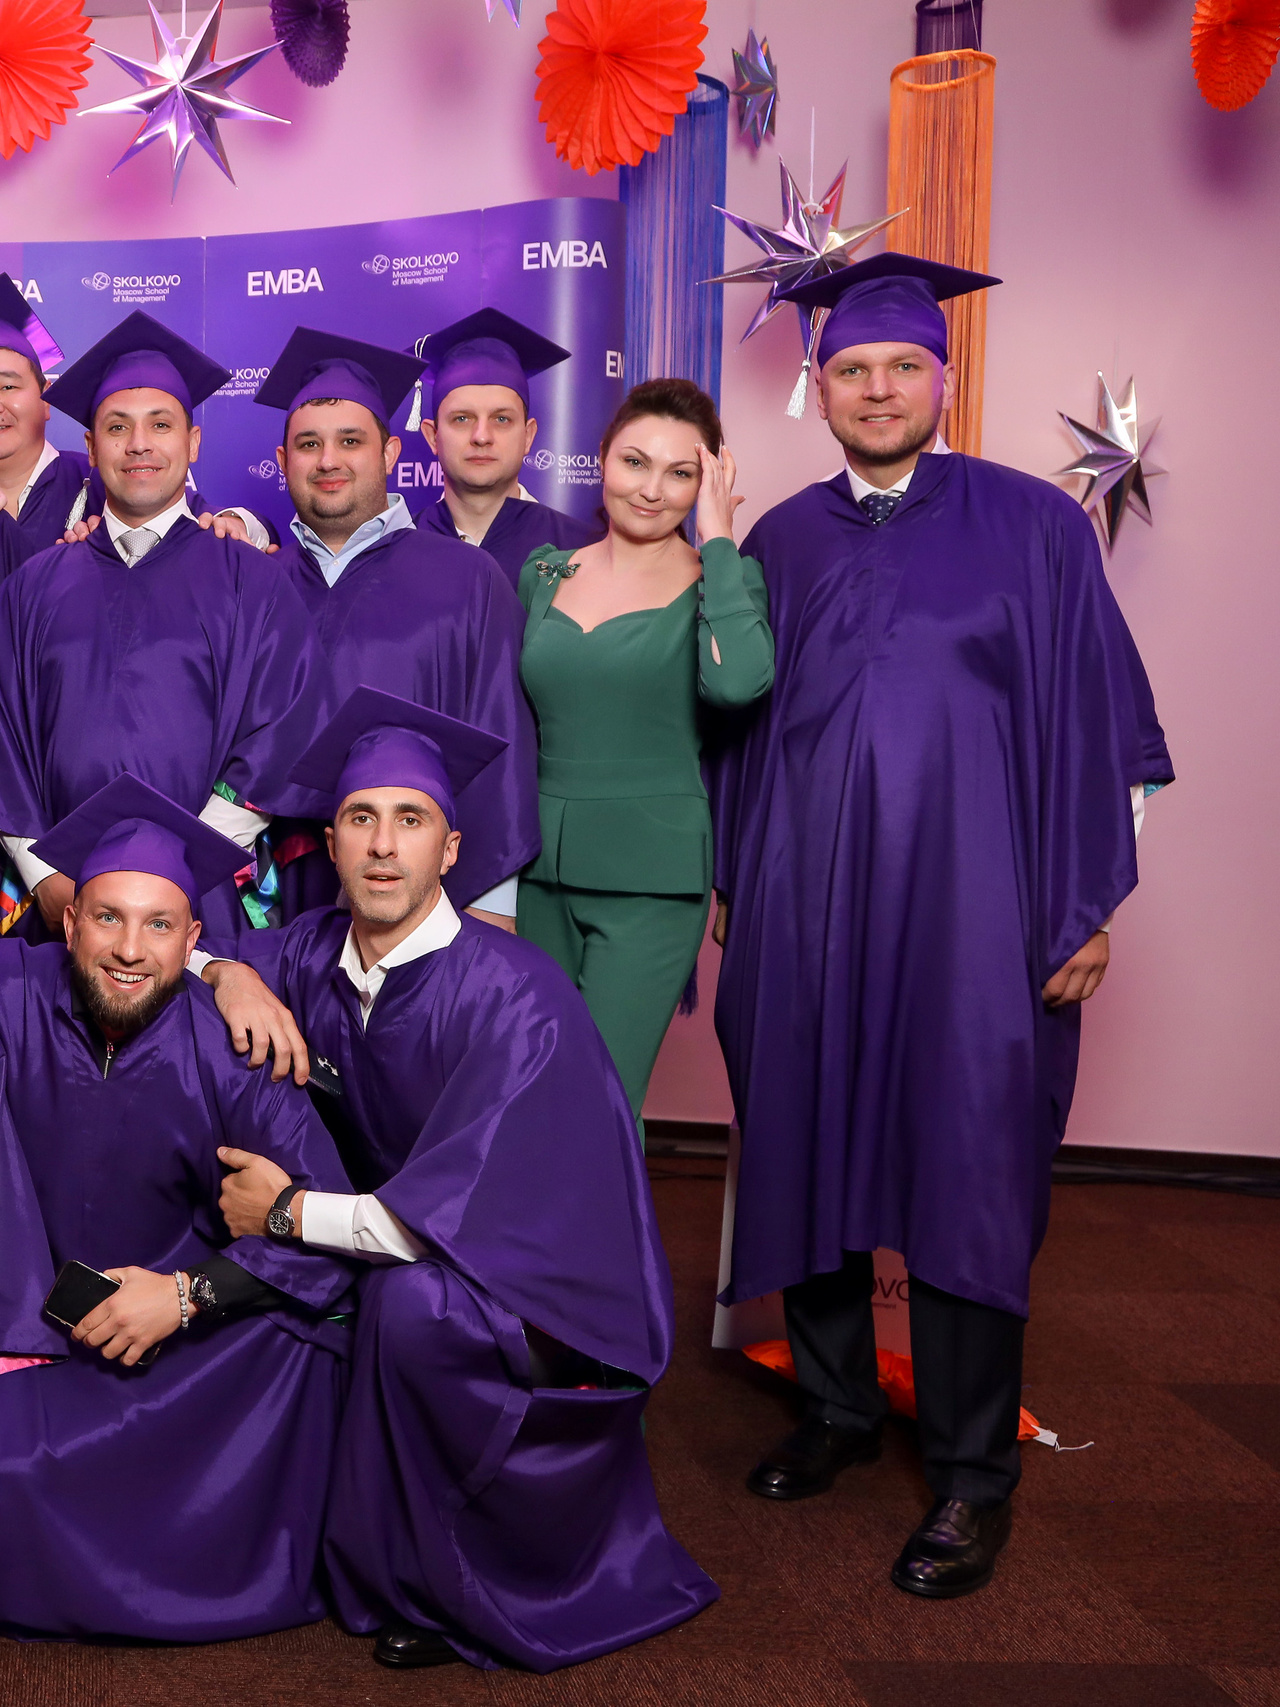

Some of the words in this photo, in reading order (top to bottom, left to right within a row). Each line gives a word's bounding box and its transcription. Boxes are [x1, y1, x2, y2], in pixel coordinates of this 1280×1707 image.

[392, 251, 459, 270] SKOLKOVO
[523, 240, 608, 271] EMBA
[424, 266, 448, 275] School
[113, 274, 181, 288] SKOLKOVO
[247, 267, 324, 296] EMBA
[392, 278, 399, 286] of
[400, 274, 444, 285] Management
[113, 288, 143, 296] Moscow
[144, 287, 170, 295] School
[121, 294, 166, 303] Management
[606, 350, 625, 379] EM
[229, 367, 270, 380] LKOVO
[235, 380, 260, 388] School
[558, 454, 601, 468] SKOLK
[398, 461, 445, 487] EM
[558, 468, 592, 477] Moscow
[567, 476, 602, 486] Manage
